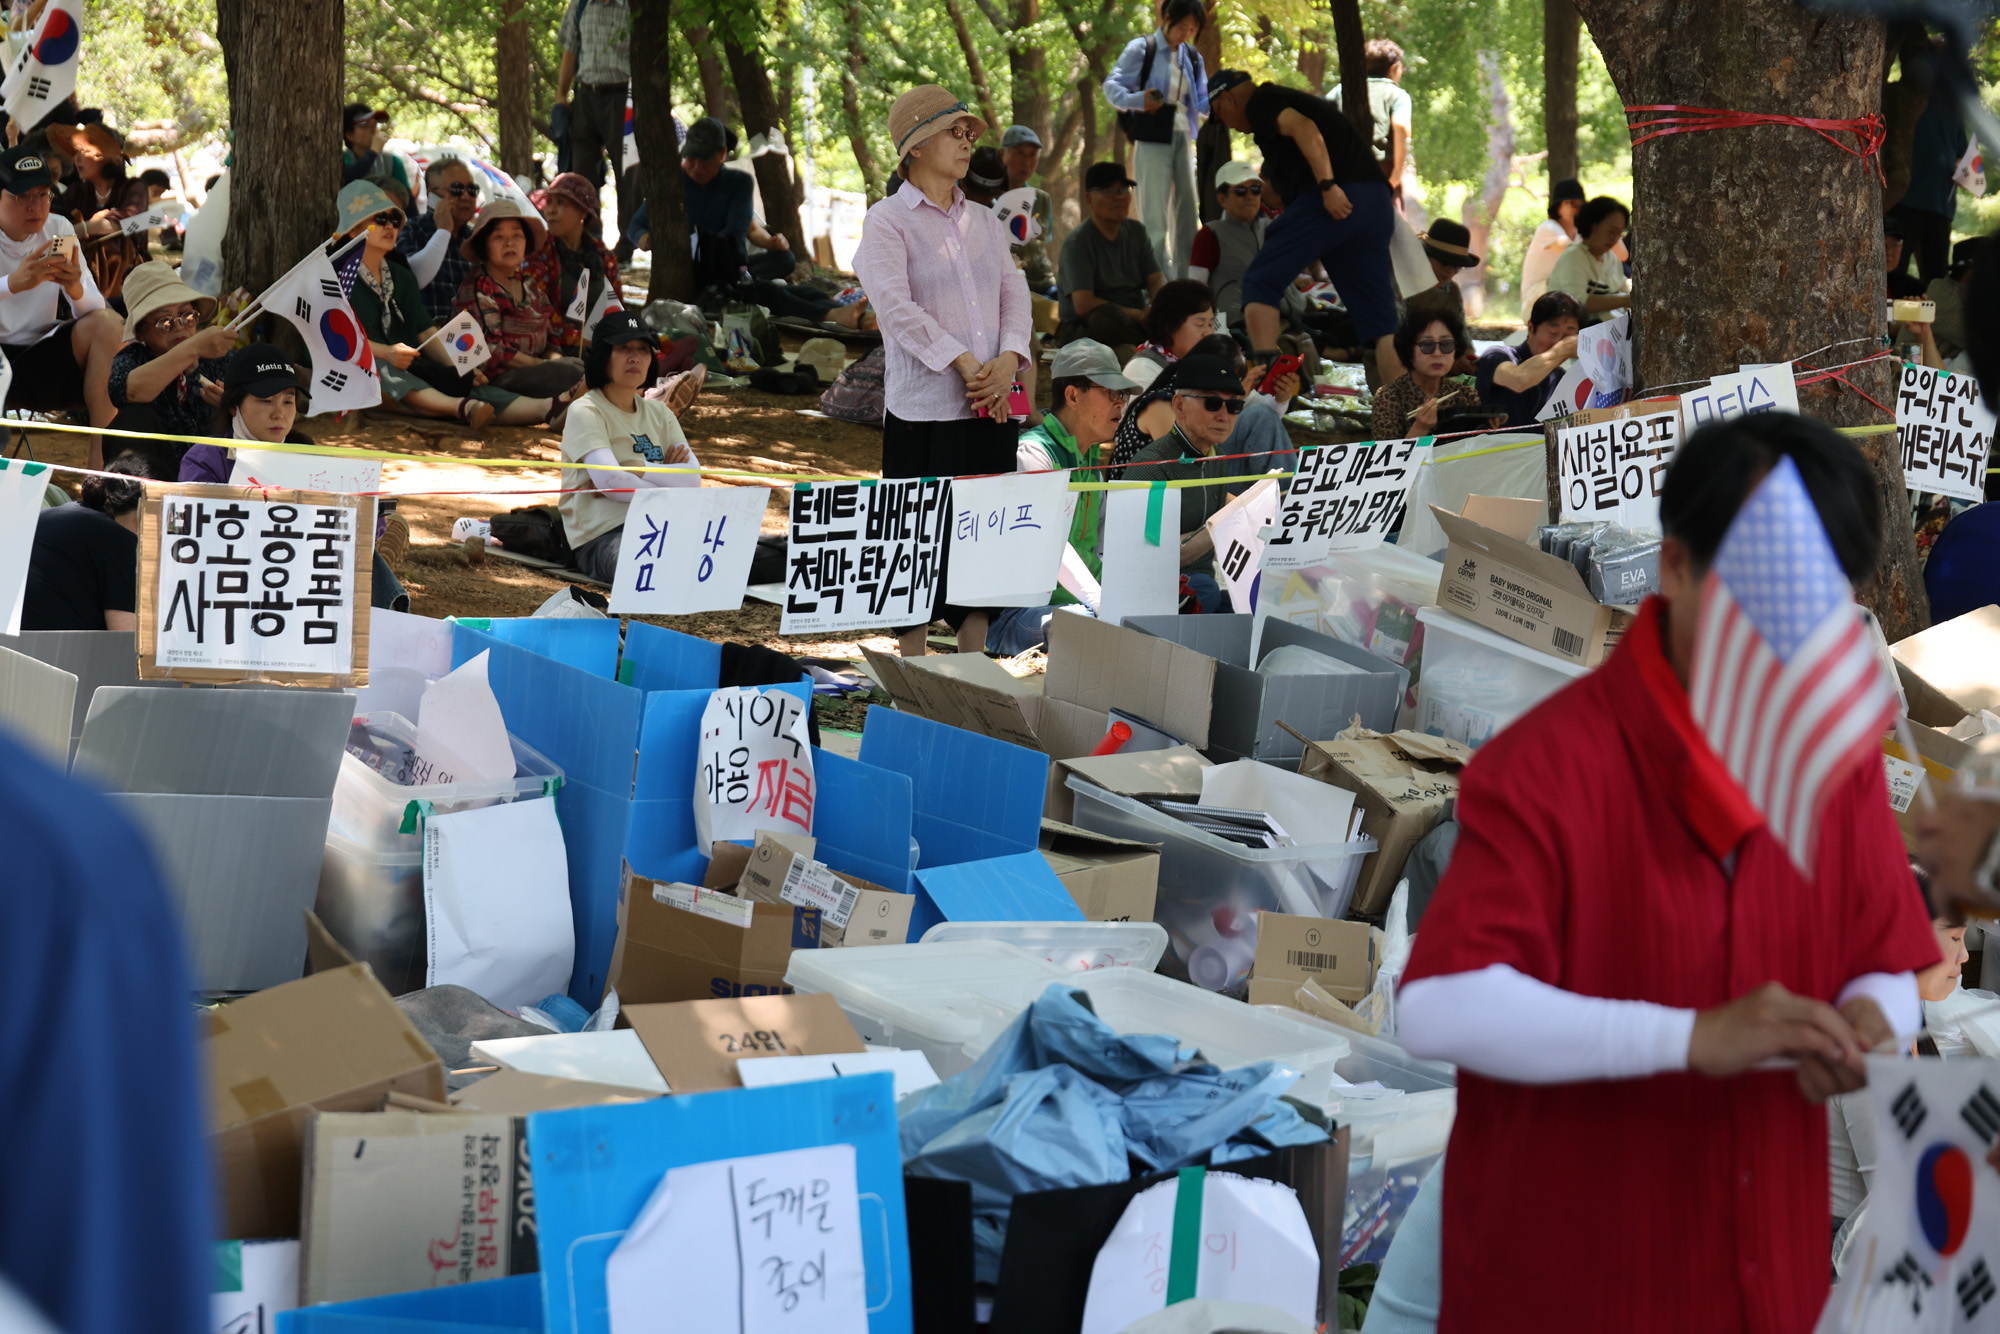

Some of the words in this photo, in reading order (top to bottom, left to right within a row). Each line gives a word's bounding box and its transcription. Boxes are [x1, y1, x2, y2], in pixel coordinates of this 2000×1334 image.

[256, 363, 282, 373] Matin
[1900, 368, 1979, 428] 우의,우산
[1291, 440, 1416, 496] 담요,마스크
[1561, 416, 1675, 510] 생활용품
[167, 503, 351, 570] 방호용품
[957, 504, 1041, 542] 테이프
[1269, 488, 1406, 546] 호루라기,모자
[634, 514, 727, 592] 침낭
[1457, 567, 1476, 581] comet
[1621, 568, 1647, 585] EVA
[163, 571, 344, 645] 사무용품
[1490, 574, 1507, 589] BABY
[1507, 581, 1526, 597] WIPES
[1525, 589, 1553, 609] ORIGINAL
[745, 758, 814, 833] 지급
[476, 1133, 500, 1270] 참나무장작
[759, 1247, 826, 1314] 종이
